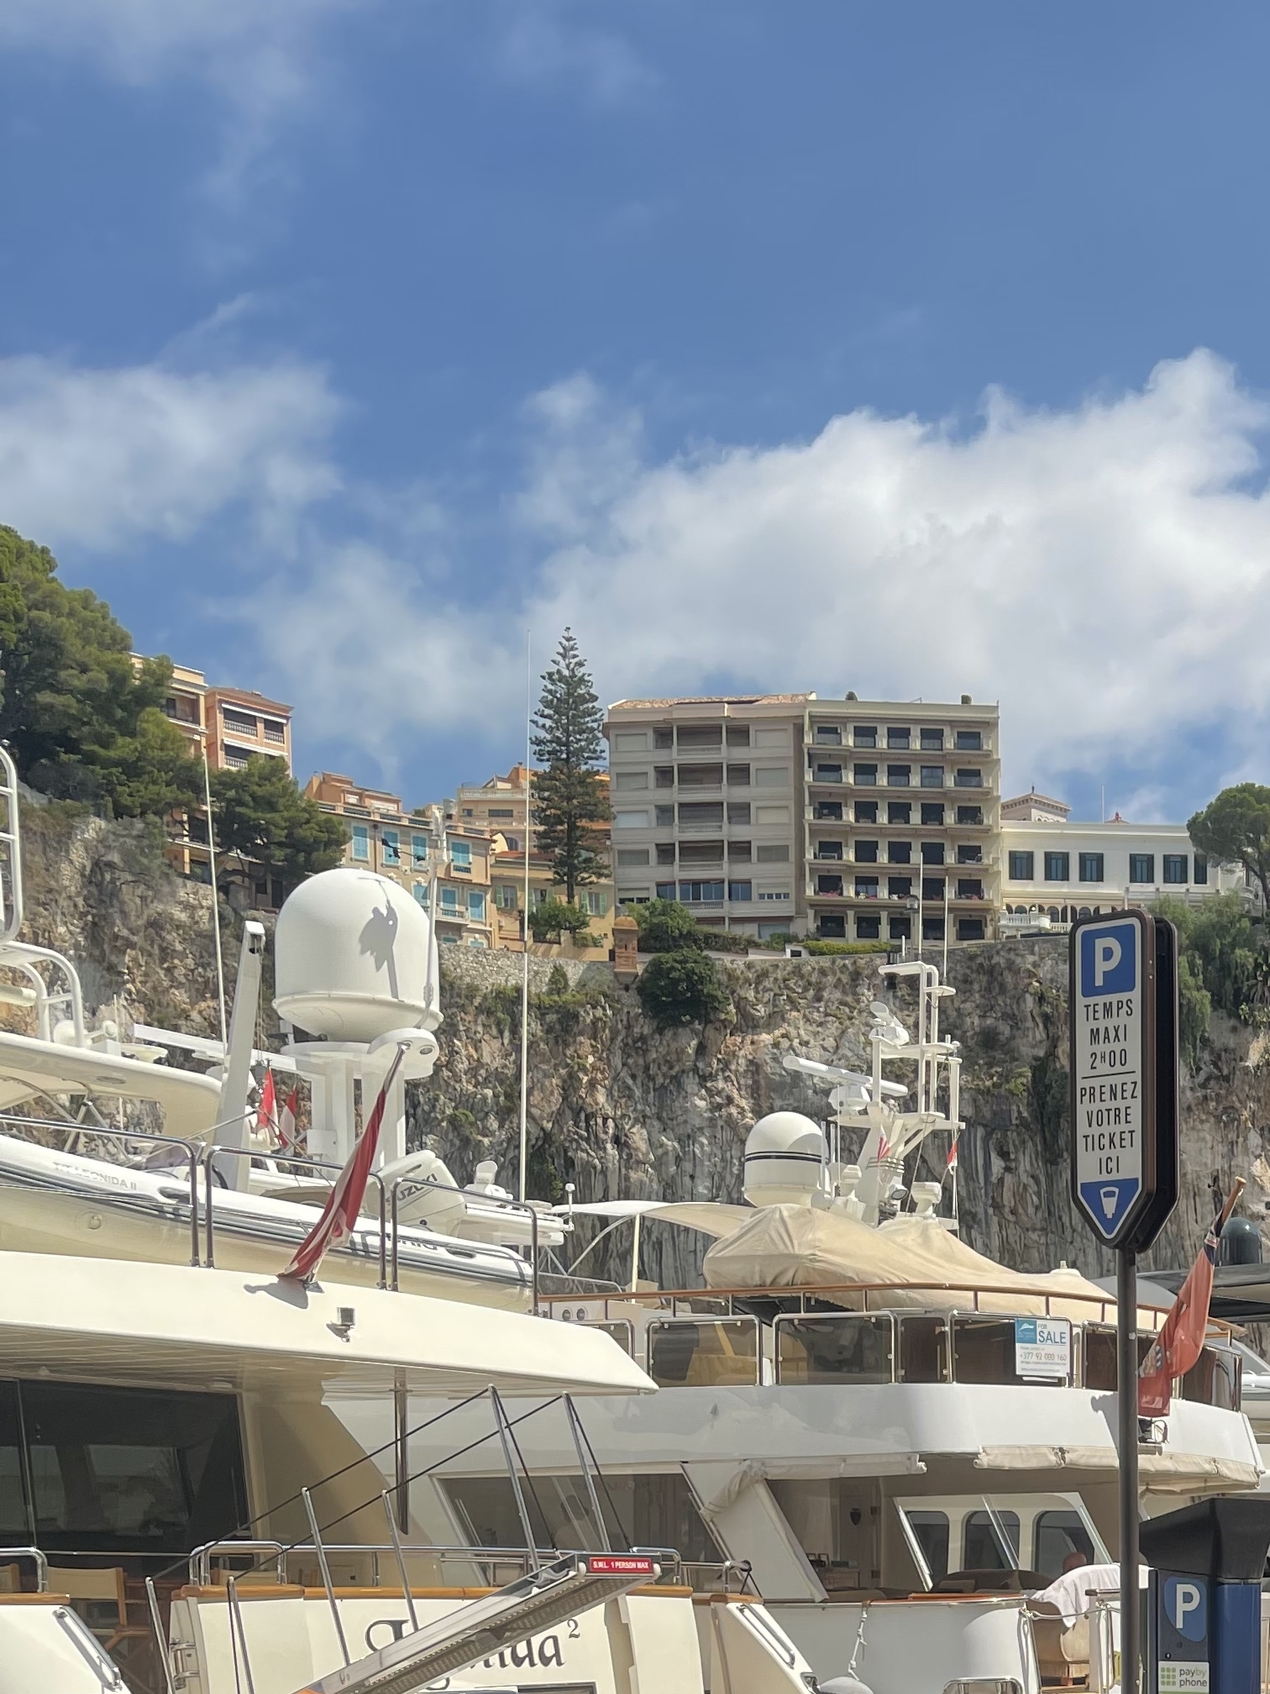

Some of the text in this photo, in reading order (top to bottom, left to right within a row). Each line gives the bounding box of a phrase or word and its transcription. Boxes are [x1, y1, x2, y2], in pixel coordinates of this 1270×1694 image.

[1094, 936, 1122, 987] P
[1083, 999, 1134, 1022] TEMPS
[1089, 1024, 1128, 1046] MAXI
[1080, 1081, 1138, 1105] PRENEZ
[1086, 1106, 1132, 1128] VOTRE
[1082, 1129, 1136, 1152] TICKET
[1098, 1155, 1121, 1176] ICI
[1038, 1330, 1067, 1345] SALE
[615, 1561, 637, 1569] PERSON
[637, 1561, 649, 1569] MAX
[1175, 1583, 1201, 1629] P
[1179, 1678, 1208, 1688] phone
